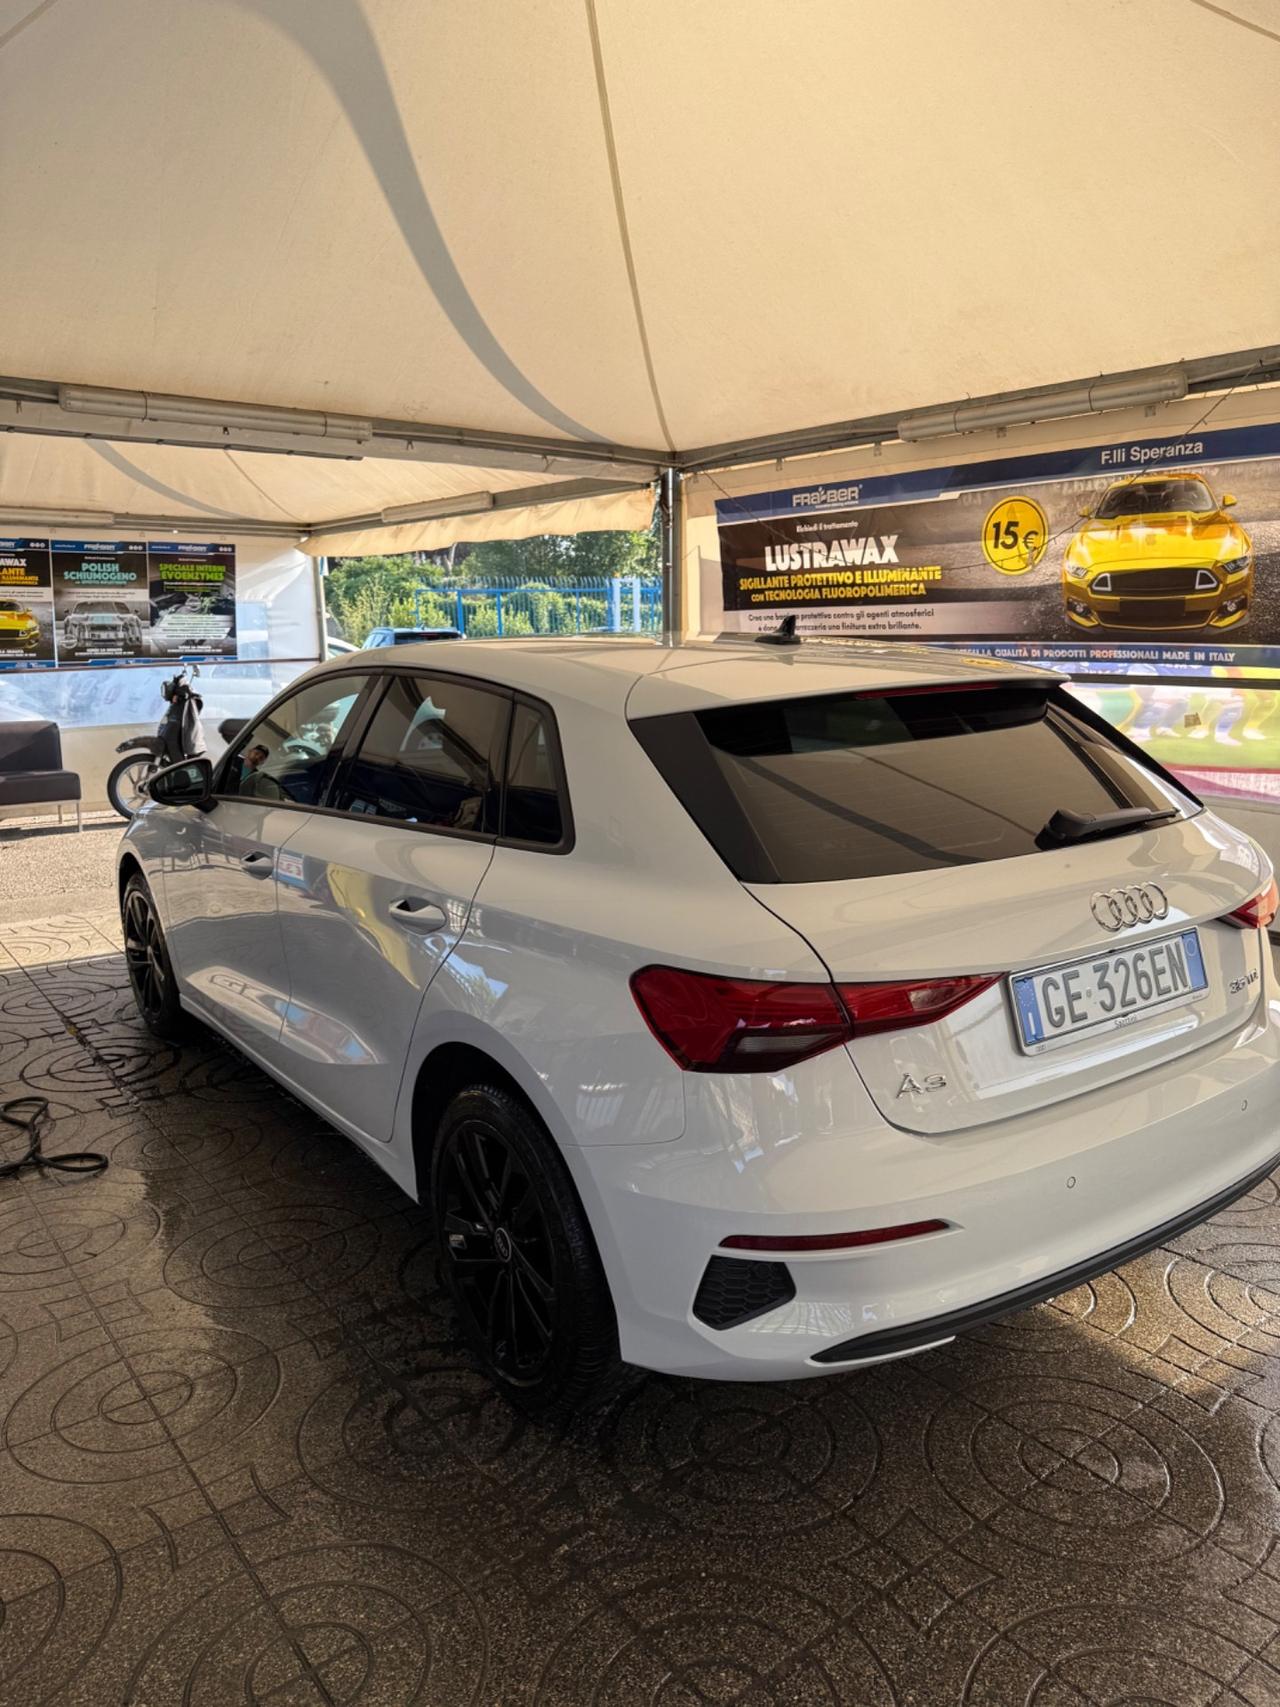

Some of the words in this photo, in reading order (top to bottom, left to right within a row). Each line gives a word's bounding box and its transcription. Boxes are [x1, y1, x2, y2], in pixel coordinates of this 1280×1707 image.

[1130, 442, 1203, 464] Speranza
[764, 535, 900, 572] LUSTRAWAX
[82, 563, 120, 572] POLISH
[740, 576, 790, 591] SIGILLANTE
[791, 571, 854, 587] PROTETTIVO
[855, 571, 863, 584] E
[863, 565, 943, 584] ILLUMINANTE
[764, 588, 821, 602] TECNOLOGIA
[822, 582, 927, 600] FLUOROPOLIMERICA
[866, 609, 890, 620] agenti
[890, 607, 935, 619] atmosferici
[994, 647, 1029, 658] QUALITÀ
[1031, 649, 1041, 658] DI
[1043, 649, 1087, 658] PRODOTTI
[1089, 650, 1159, 660] PROFESSIONALI
[1161, 651, 1191, 661] MADE
[1193, 652, 1206, 661] IN
[1209, 652, 1237, 663] ITALY
[895, 1072, 947, 1100] A3
